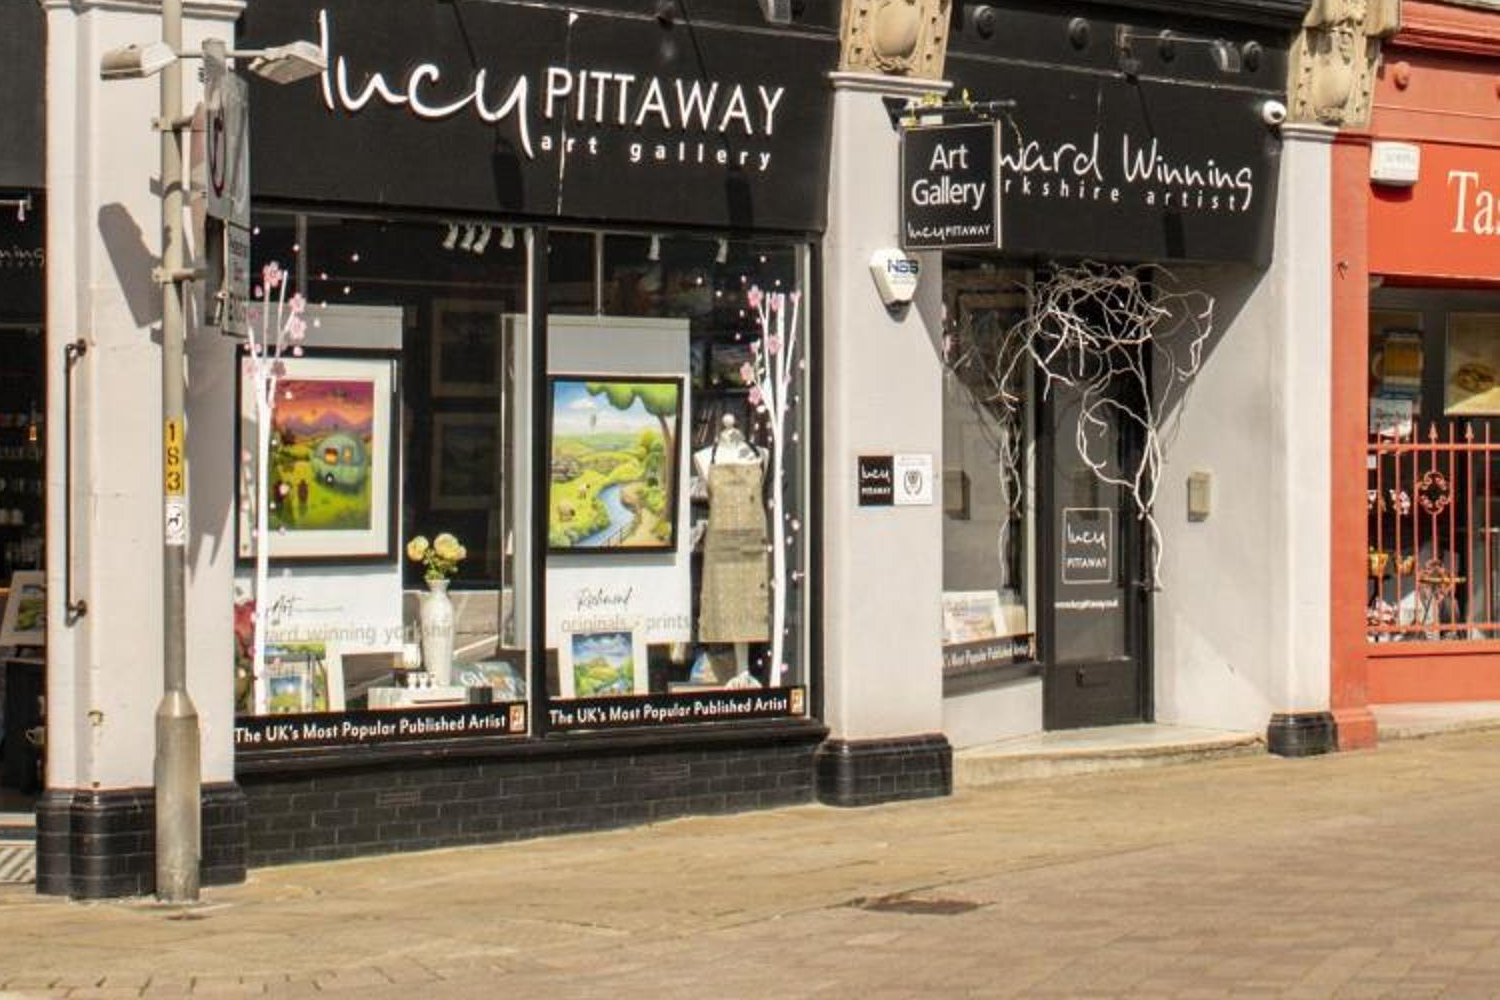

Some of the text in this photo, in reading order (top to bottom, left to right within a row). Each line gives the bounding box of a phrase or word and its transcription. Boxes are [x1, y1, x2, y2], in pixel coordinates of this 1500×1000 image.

[319, 8, 786, 159] lucy PITTAWAY
[541, 135, 771, 172] art gallery
[929, 143, 969, 171] Art
[999, 132, 1253, 212] ward Winning
[911, 175, 986, 211] Gallery
[1005, 176, 1120, 203] rkshire
[1447, 169, 1500, 236] Ta
[907, 221, 991, 241] lucy PITTAWAY
[550, 697, 787, 725] The UK's Most Popular Published Artist
[235, 713, 506, 744] The UK's Most Popular Published Artist
